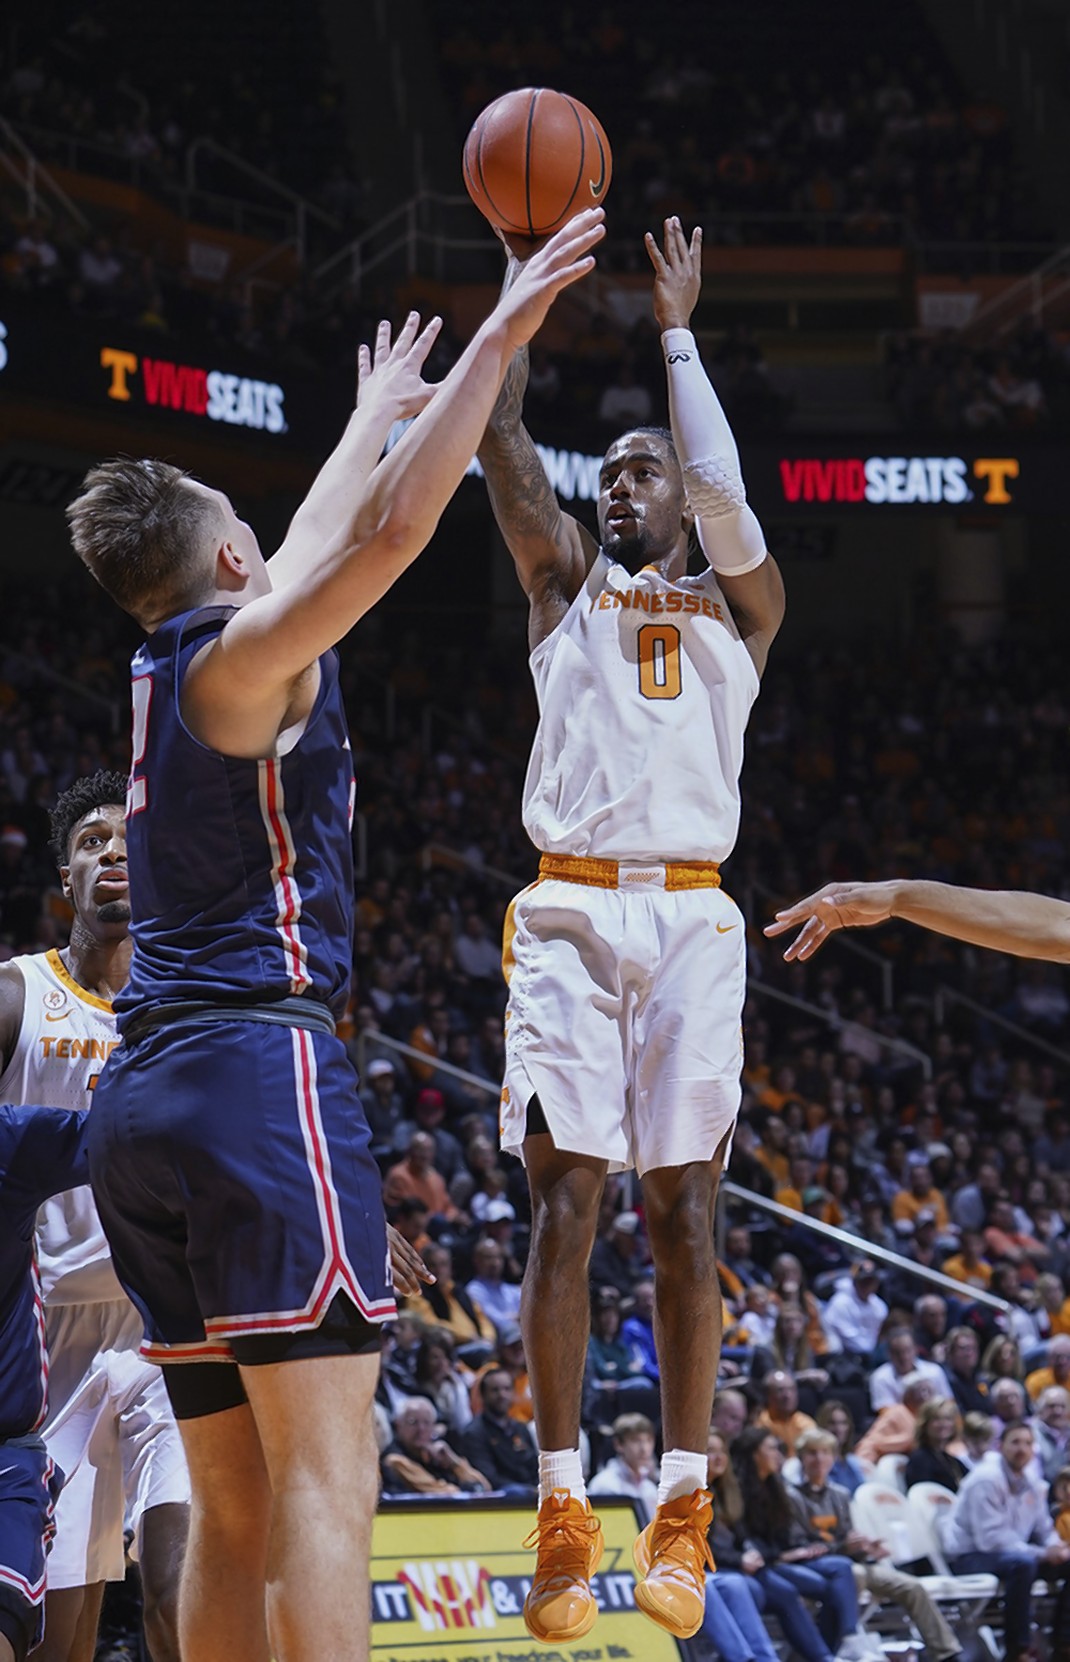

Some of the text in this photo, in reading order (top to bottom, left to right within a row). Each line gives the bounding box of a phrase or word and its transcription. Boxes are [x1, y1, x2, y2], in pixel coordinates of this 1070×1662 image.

[101, 347, 137, 401] T
[973, 458, 1019, 503] T
[637, 623, 682, 700] 0
